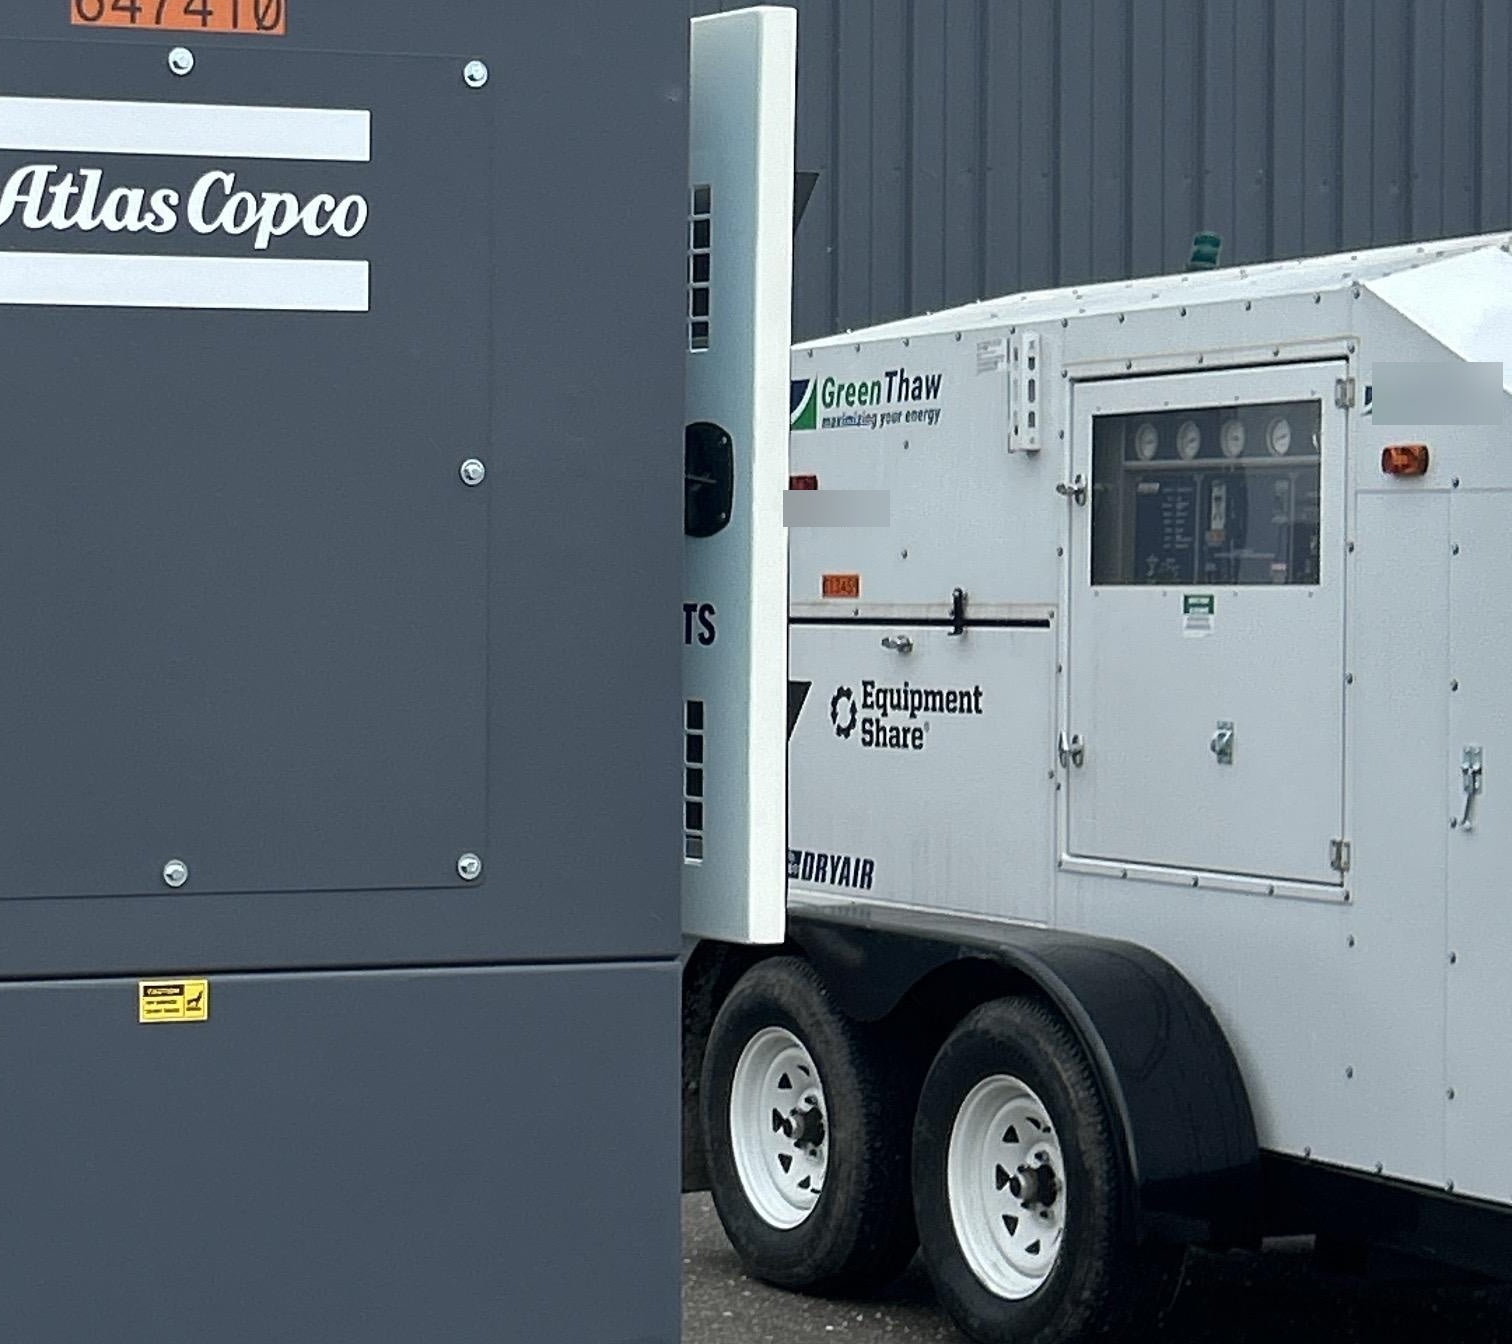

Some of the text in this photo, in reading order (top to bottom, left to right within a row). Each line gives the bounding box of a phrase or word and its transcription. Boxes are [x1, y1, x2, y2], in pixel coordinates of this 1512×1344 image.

[188, 169, 369, 250] Copco
[861, 680, 983, 719] Equipment
[800, 851, 875, 890] DRYAIR
